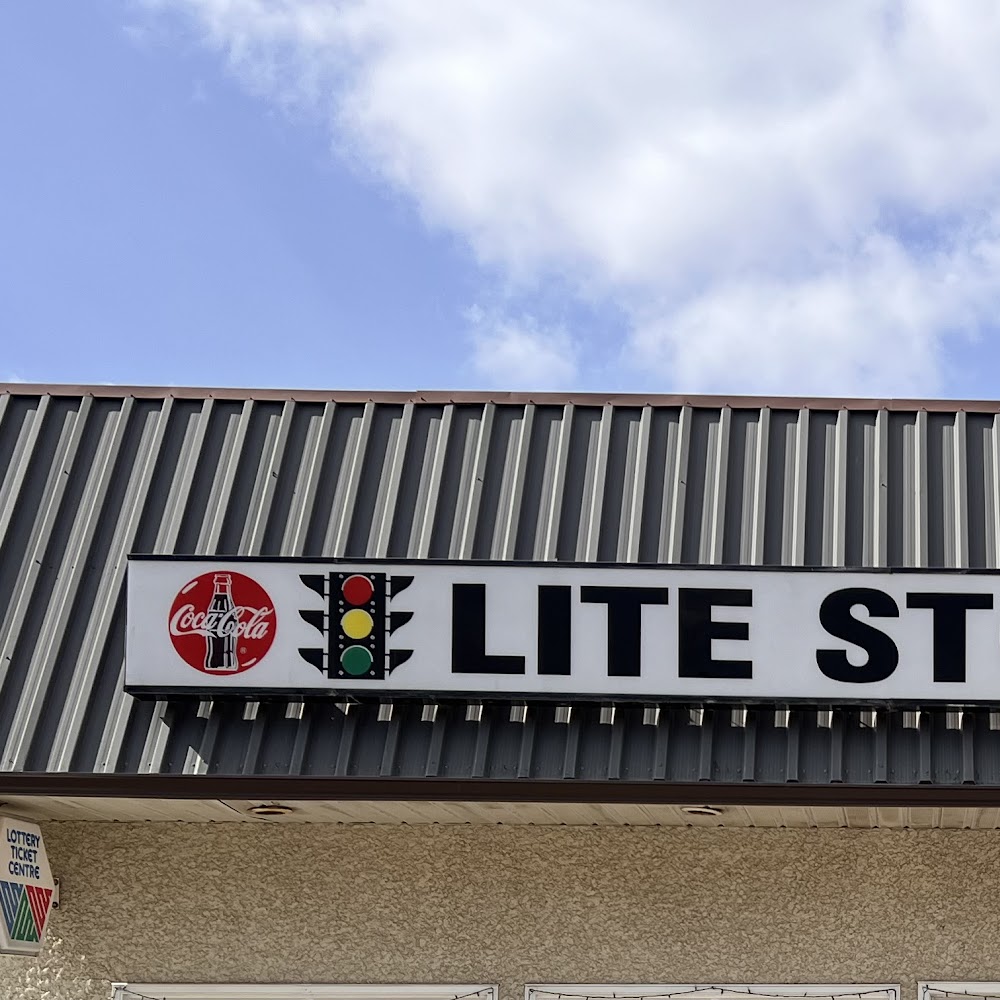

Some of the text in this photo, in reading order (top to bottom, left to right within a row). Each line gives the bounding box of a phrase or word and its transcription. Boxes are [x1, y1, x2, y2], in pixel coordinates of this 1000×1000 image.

[169, 604, 274, 639] Coca-Cola
[452, 583, 753, 679] LITE
[6, 828, 40, 848] LOTTERY
[11, 845, 38, 863] TICKET
[8, 861, 40, 879] CENTRE
